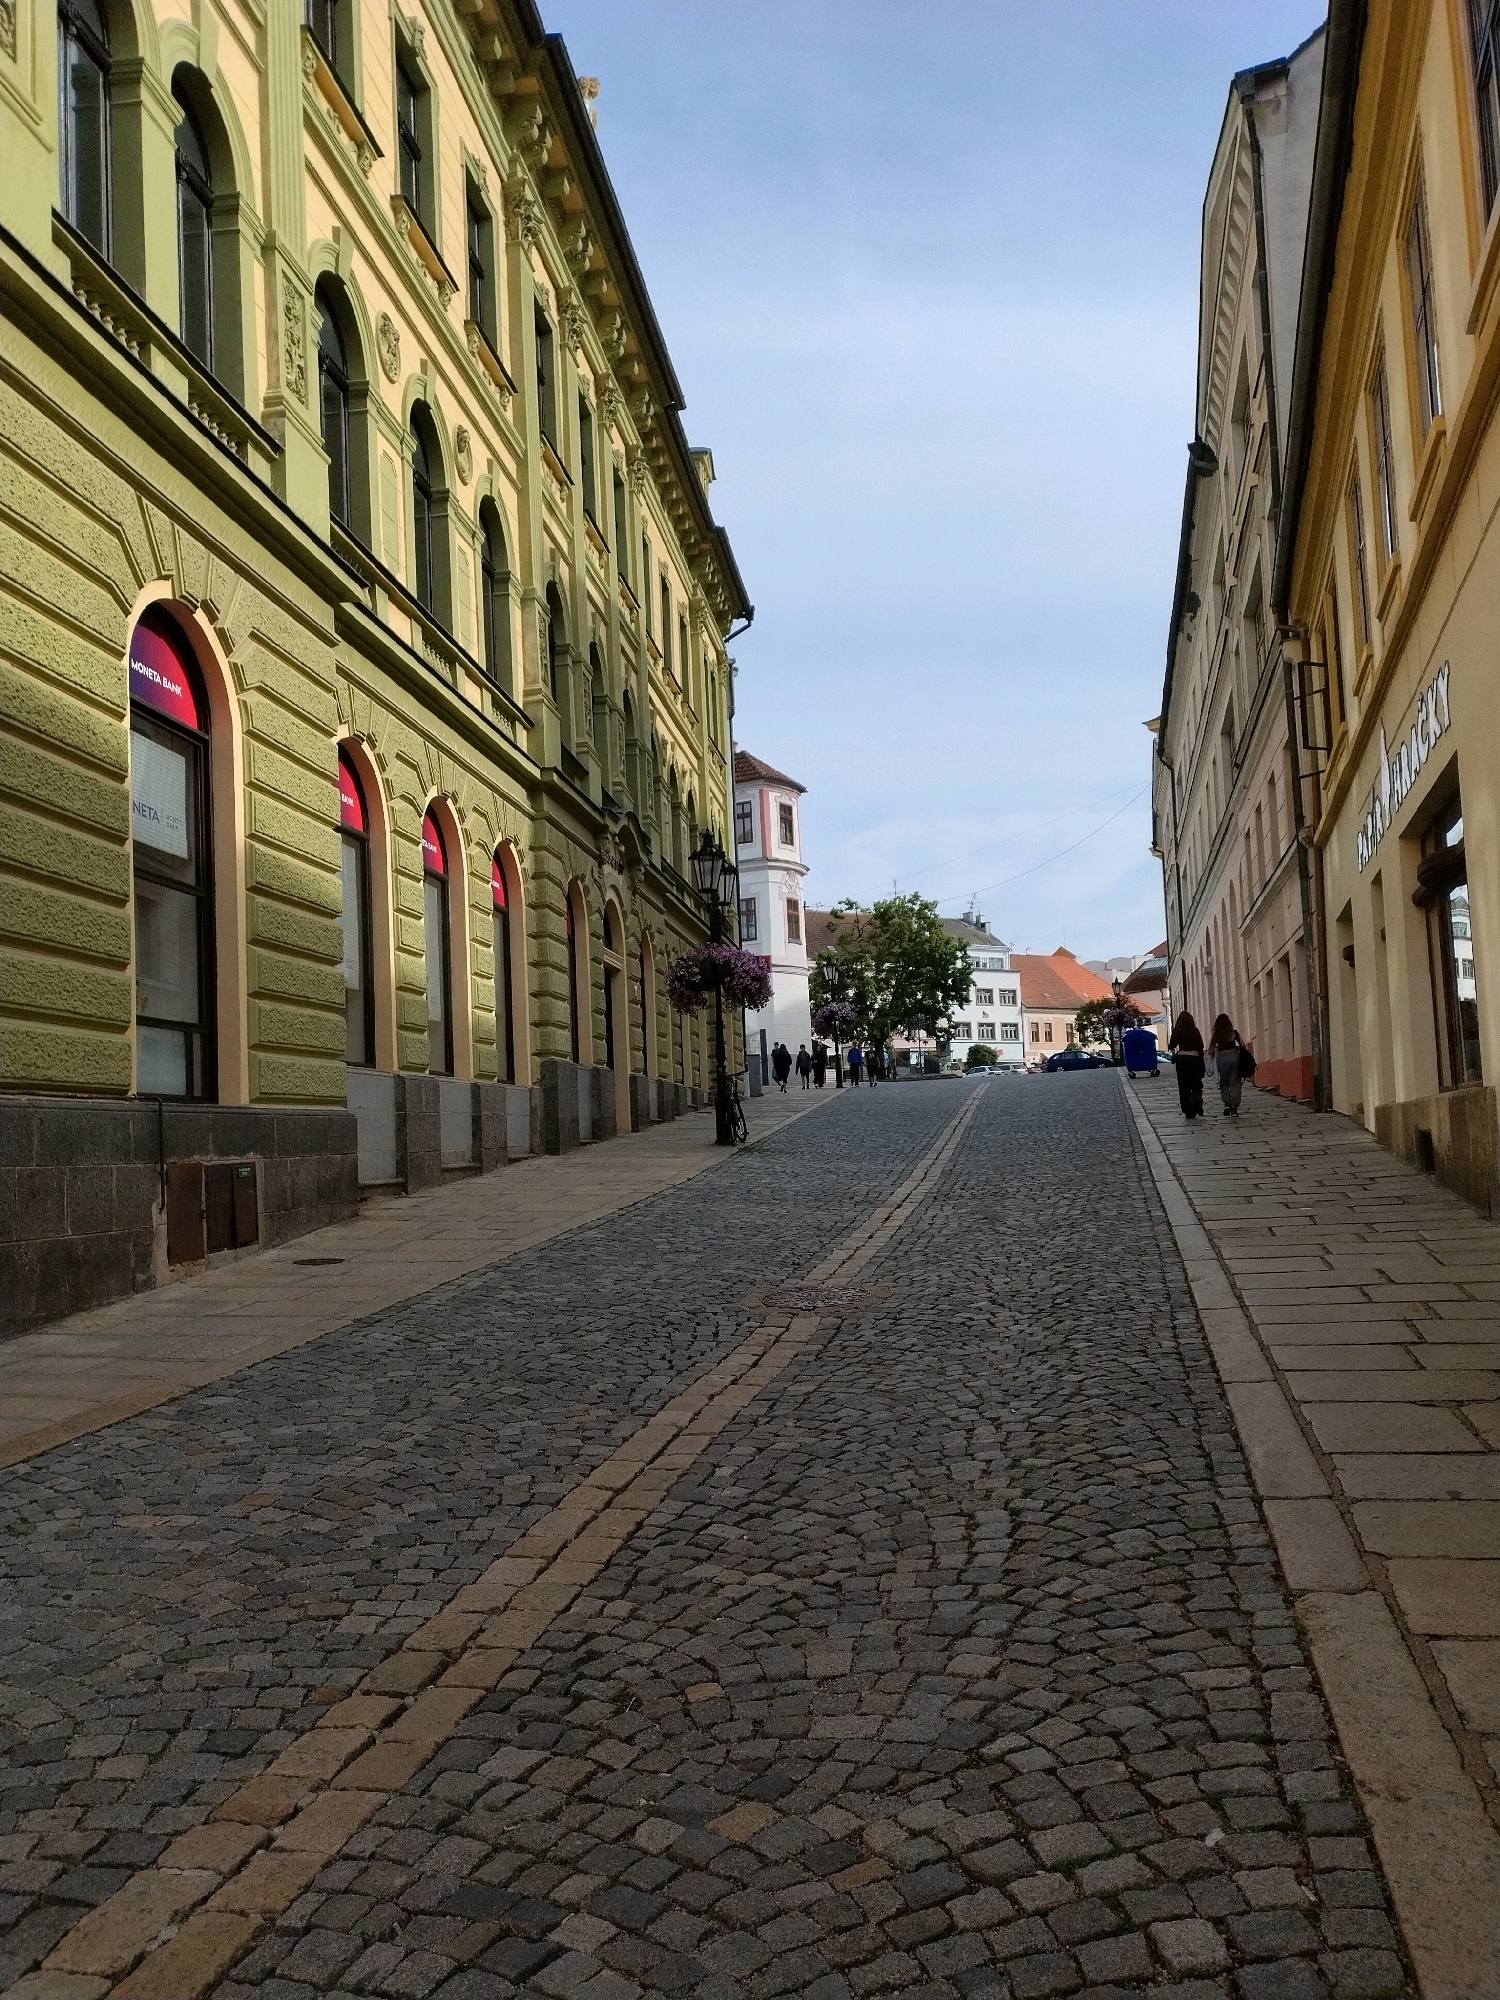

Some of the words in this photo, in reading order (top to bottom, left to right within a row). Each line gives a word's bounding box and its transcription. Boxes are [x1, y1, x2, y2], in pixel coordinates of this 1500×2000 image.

[131, 659, 161, 685] MONETA
[163, 676, 182, 697] BANK
[1392, 660, 1451, 813] HRAČKY
[133, 800, 160, 823] NETA
